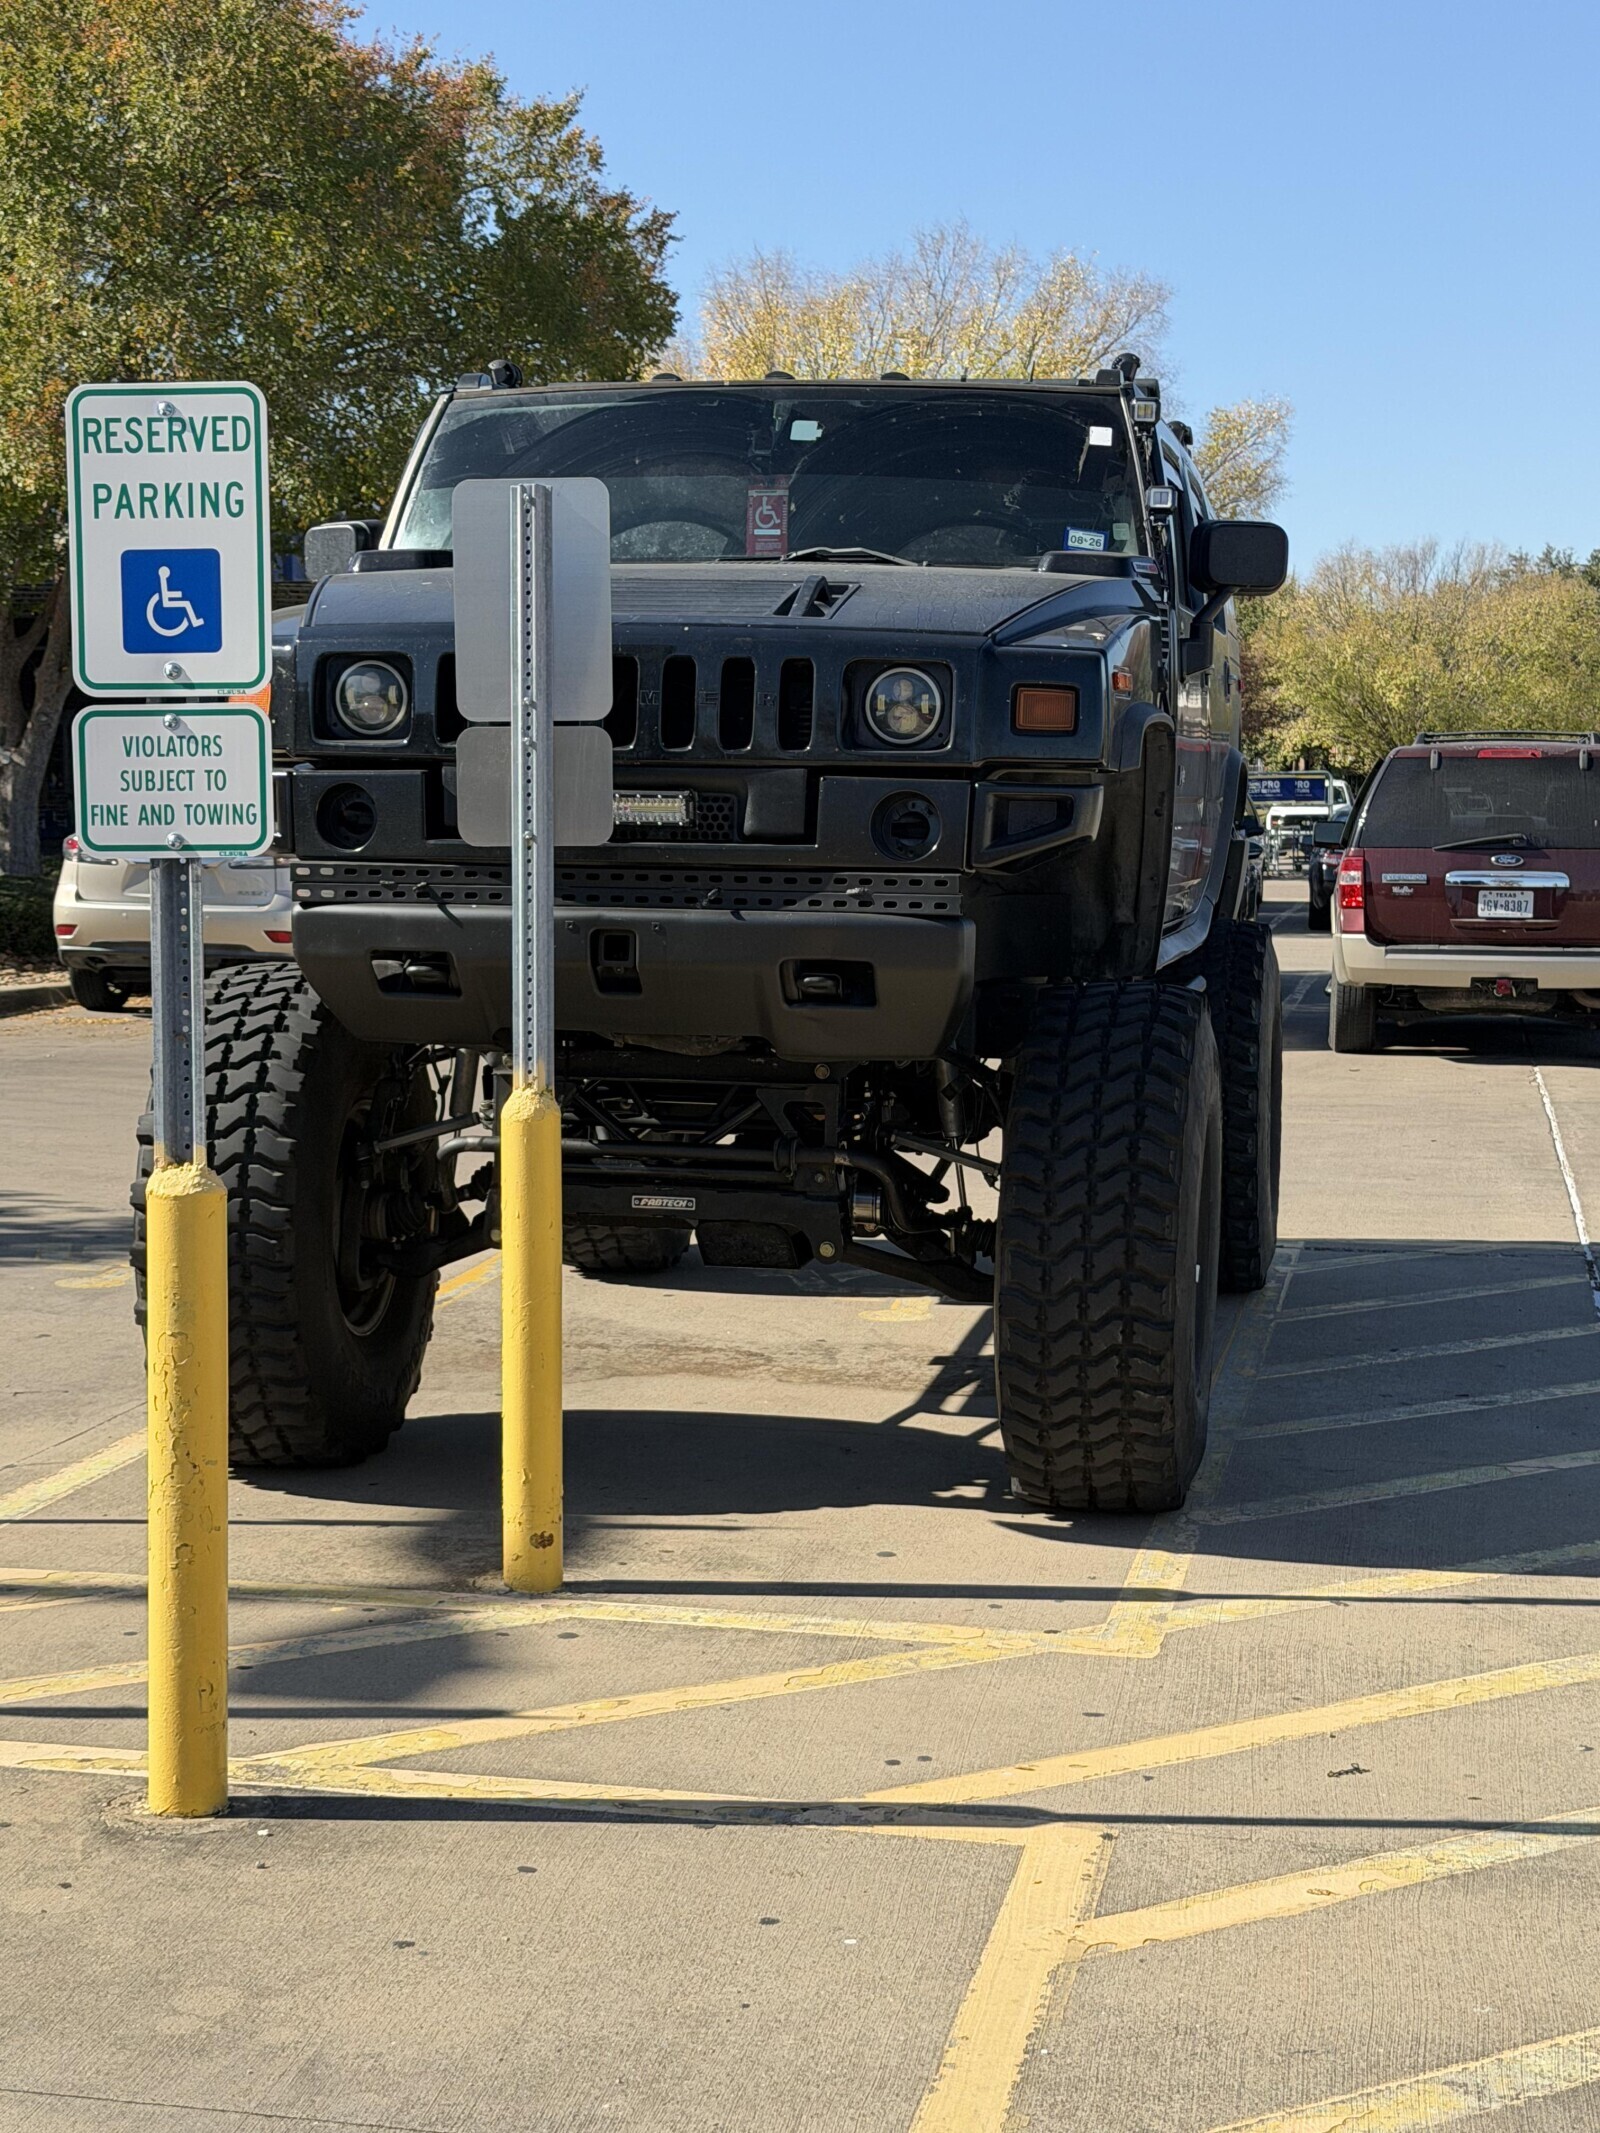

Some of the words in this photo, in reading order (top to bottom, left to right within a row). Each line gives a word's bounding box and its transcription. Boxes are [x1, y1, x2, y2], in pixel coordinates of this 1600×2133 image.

[82, 416, 251, 454] RESERVED
[93, 481, 244, 519] PARKING
[122, 735, 223, 757] VIOLATORS
[120, 769, 195, 792] SUBJECT
[204, 769, 227, 791] TO
[1261, 780, 1281, 789] PRO
[91, 804, 129, 826] FINE
[138, 804, 175, 826] AND
[184, 803, 257, 825] TOWING
[640, 1198, 688, 1208] FABTECH
